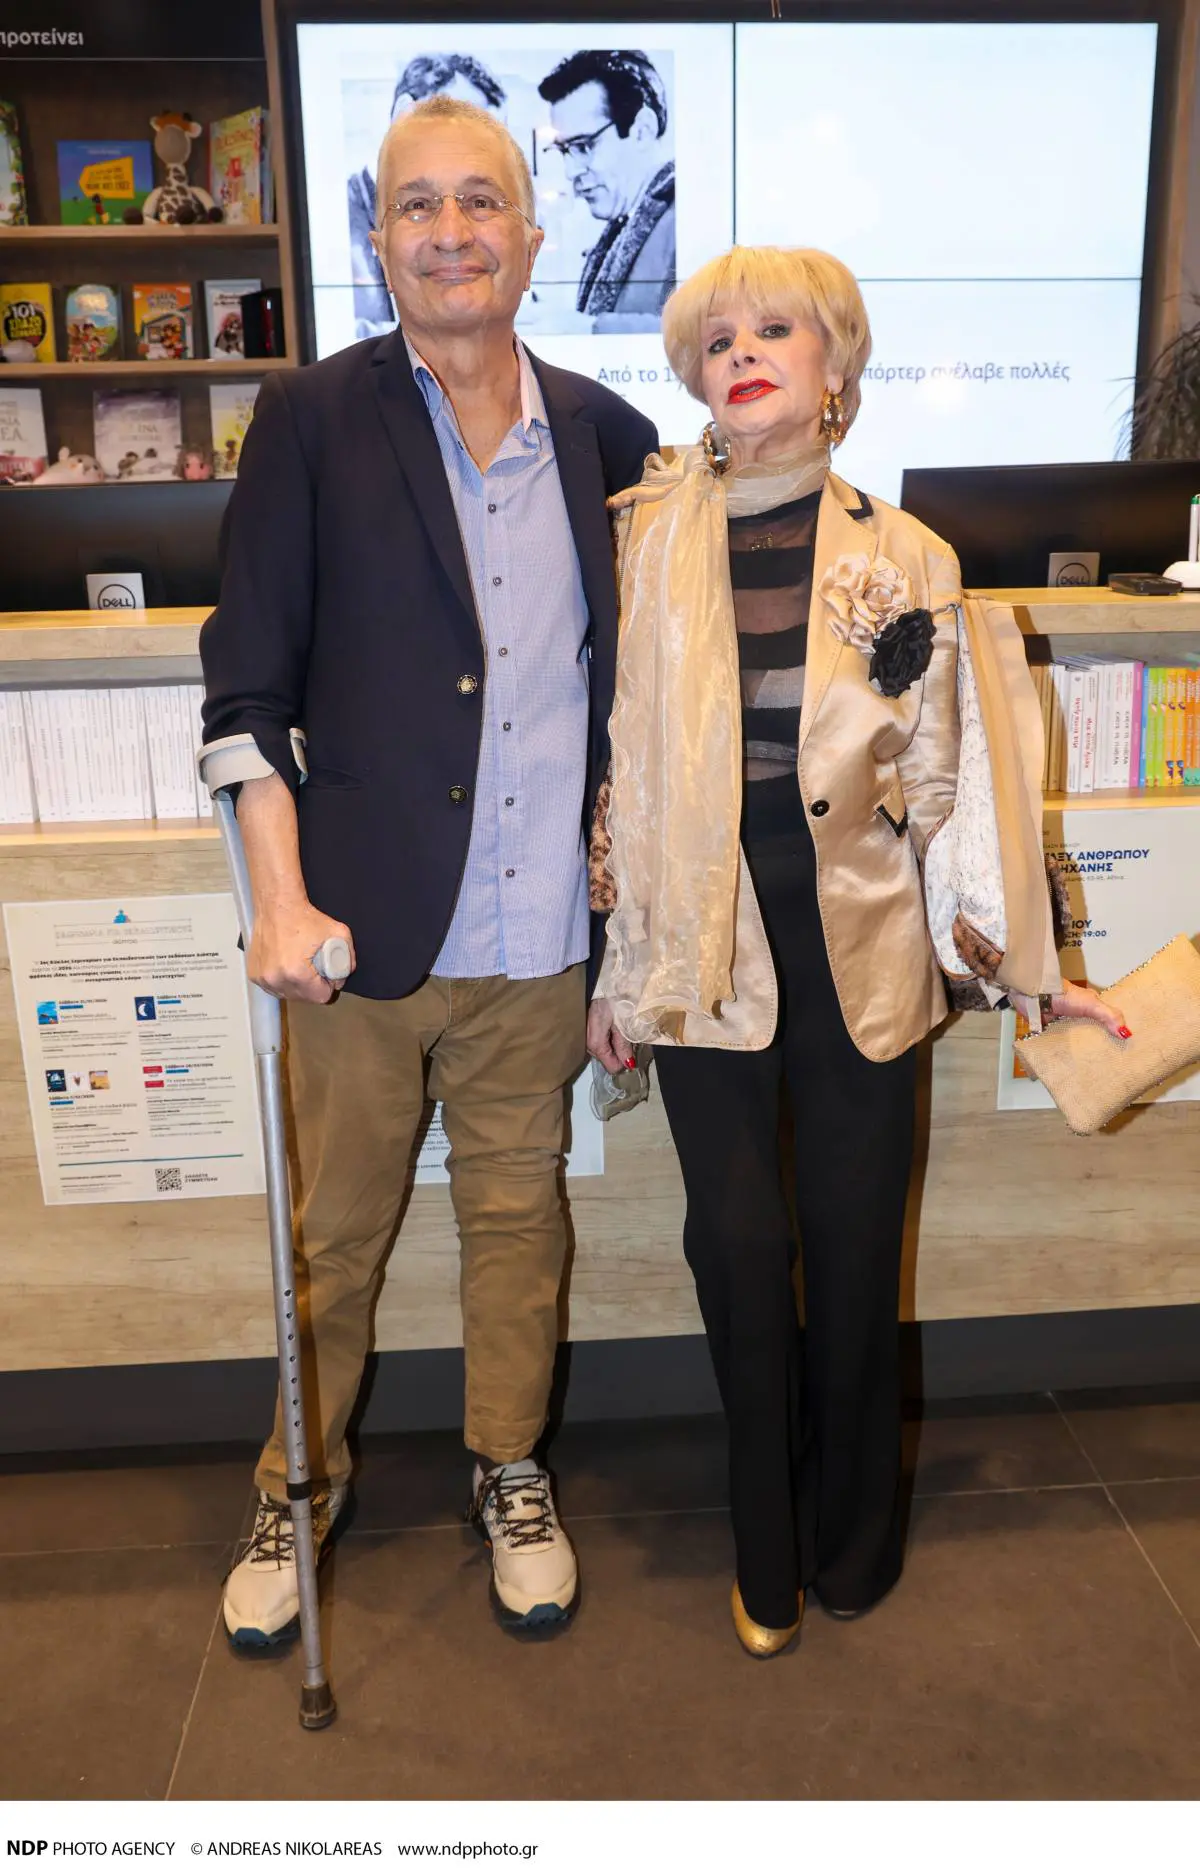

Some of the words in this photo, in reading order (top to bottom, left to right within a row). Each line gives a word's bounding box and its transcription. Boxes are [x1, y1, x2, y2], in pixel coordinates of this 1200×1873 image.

[597, 364, 632, 383] Από
[638, 369, 658, 383] το
[863, 362, 926, 384] πόρτερ
[931, 362, 1005, 384] ανέλαβε
[1009, 362, 1071, 382] πολλές
[102, 597, 132, 608] DELL
[1044, 851, 1073, 862] ΤΑΞΥ
[1077, 849, 1150, 861] ΑΝΘΡΩΠΟΥ
[1061, 862, 1113, 873] ΗΧΑΝΗΣ
[1072, 919, 1092, 929] ΙΟΥ
[1083, 930, 1107, 938] 19:00
